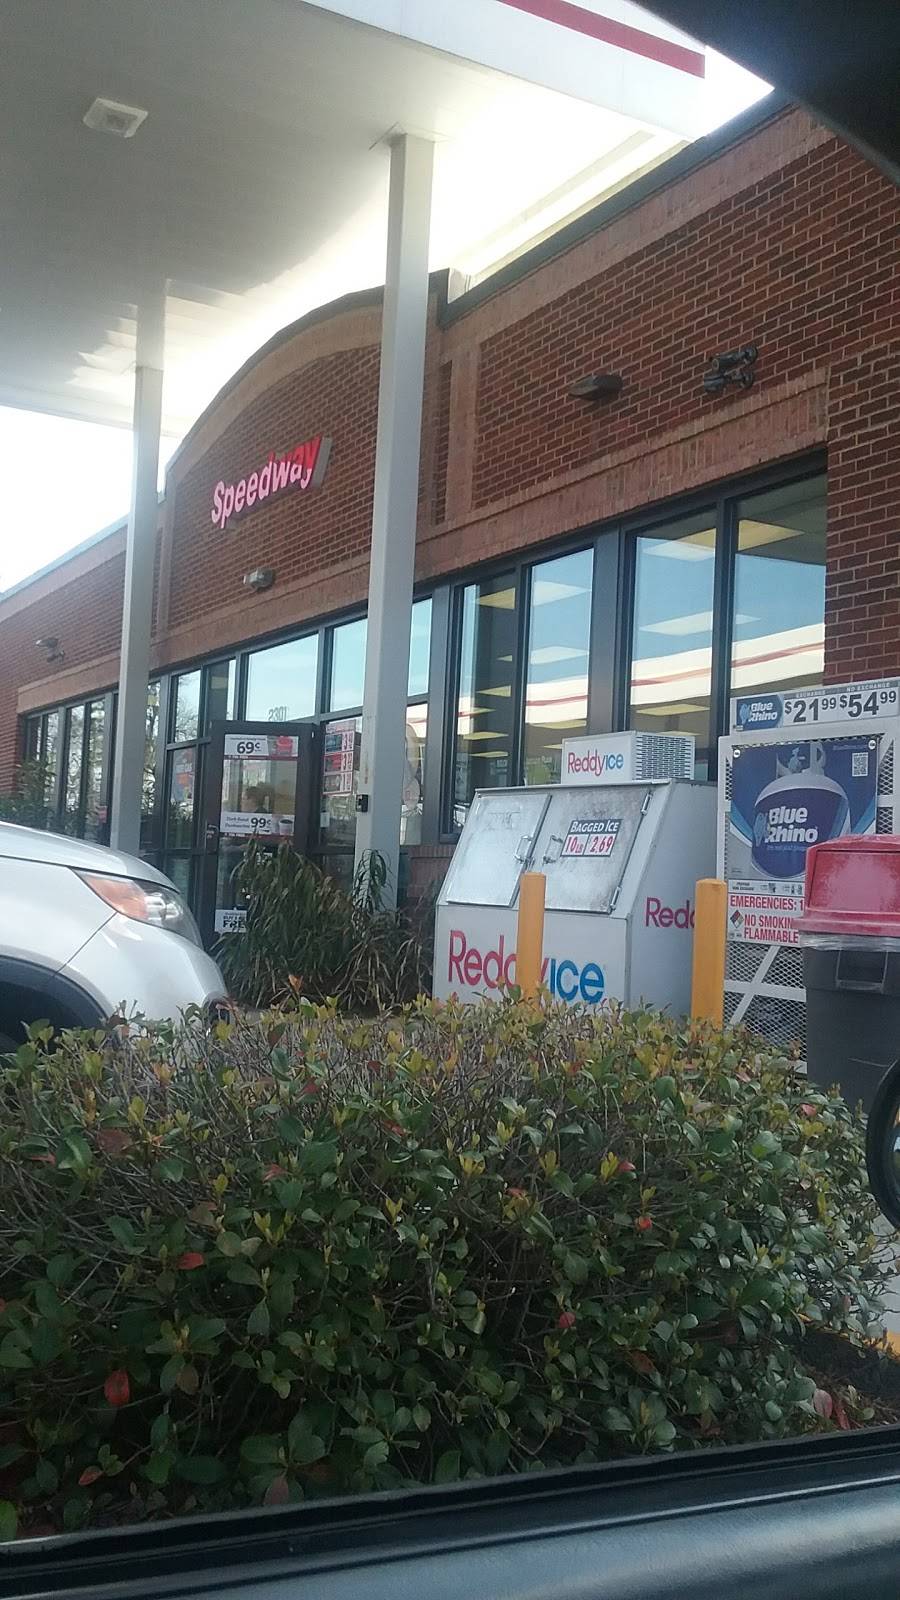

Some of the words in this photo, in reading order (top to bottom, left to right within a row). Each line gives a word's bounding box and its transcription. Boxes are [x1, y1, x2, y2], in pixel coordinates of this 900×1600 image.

[211, 434, 321, 529] Speedway
[858, 682, 890, 691] EXCHANGE
[751, 702, 773, 712] Blue
[748, 712, 778, 722] Rhino
[769, 806, 808, 825] Blue
[570, 821, 605, 833] BAGGED
[604, 820, 620, 832] ICE
[764, 824, 818, 843] Rhino
[730, 895, 797, 911] EMERGENCIES:
[744, 914, 757, 926] NO
[743, 927, 799, 943] FLAMMABLE
